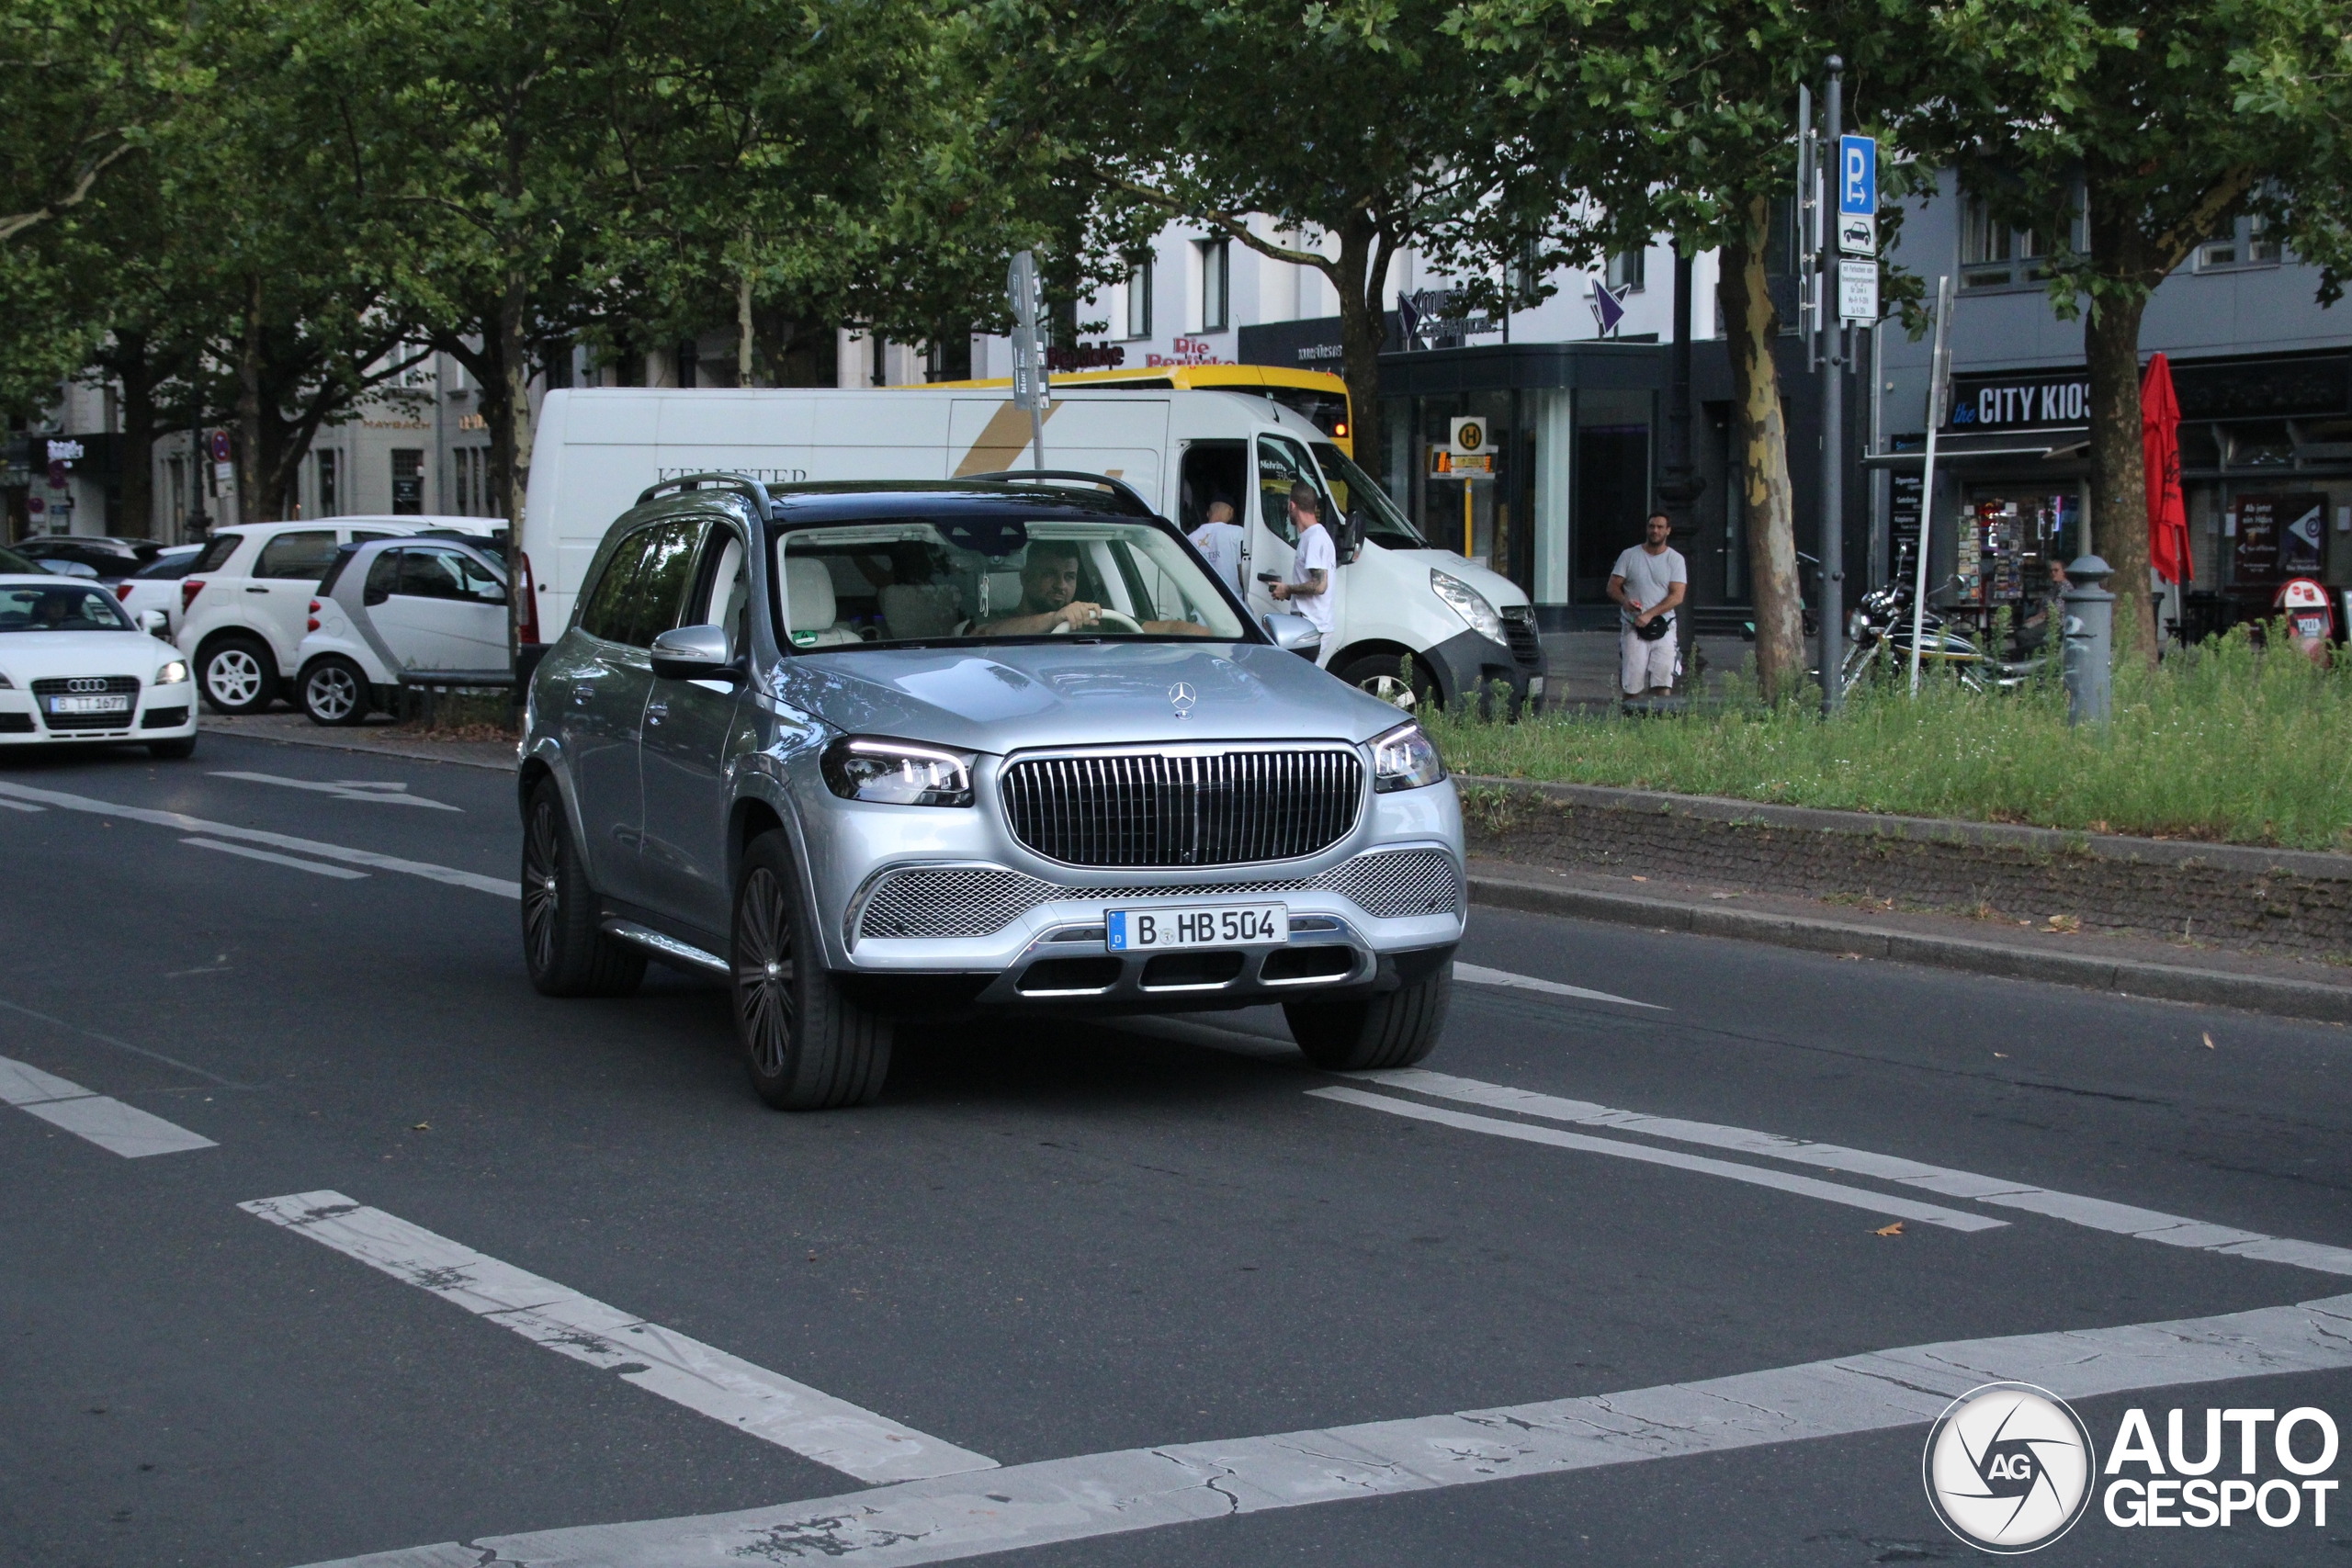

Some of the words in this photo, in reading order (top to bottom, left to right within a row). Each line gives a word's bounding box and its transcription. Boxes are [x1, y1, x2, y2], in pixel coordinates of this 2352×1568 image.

[1846, 148, 1865, 203] P
[1173, 337, 1209, 355] Die
[1953, 403, 1975, 423] the
[1979, 388, 2035, 423] CITY
[76, 697, 91, 709] TT
[96, 697, 125, 709] 1677
[1114, 935, 1122, 943] D
[1138, 916, 1157, 944] B
[1178, 912, 1216, 942] HB
[1222, 910, 1274, 940] 504
